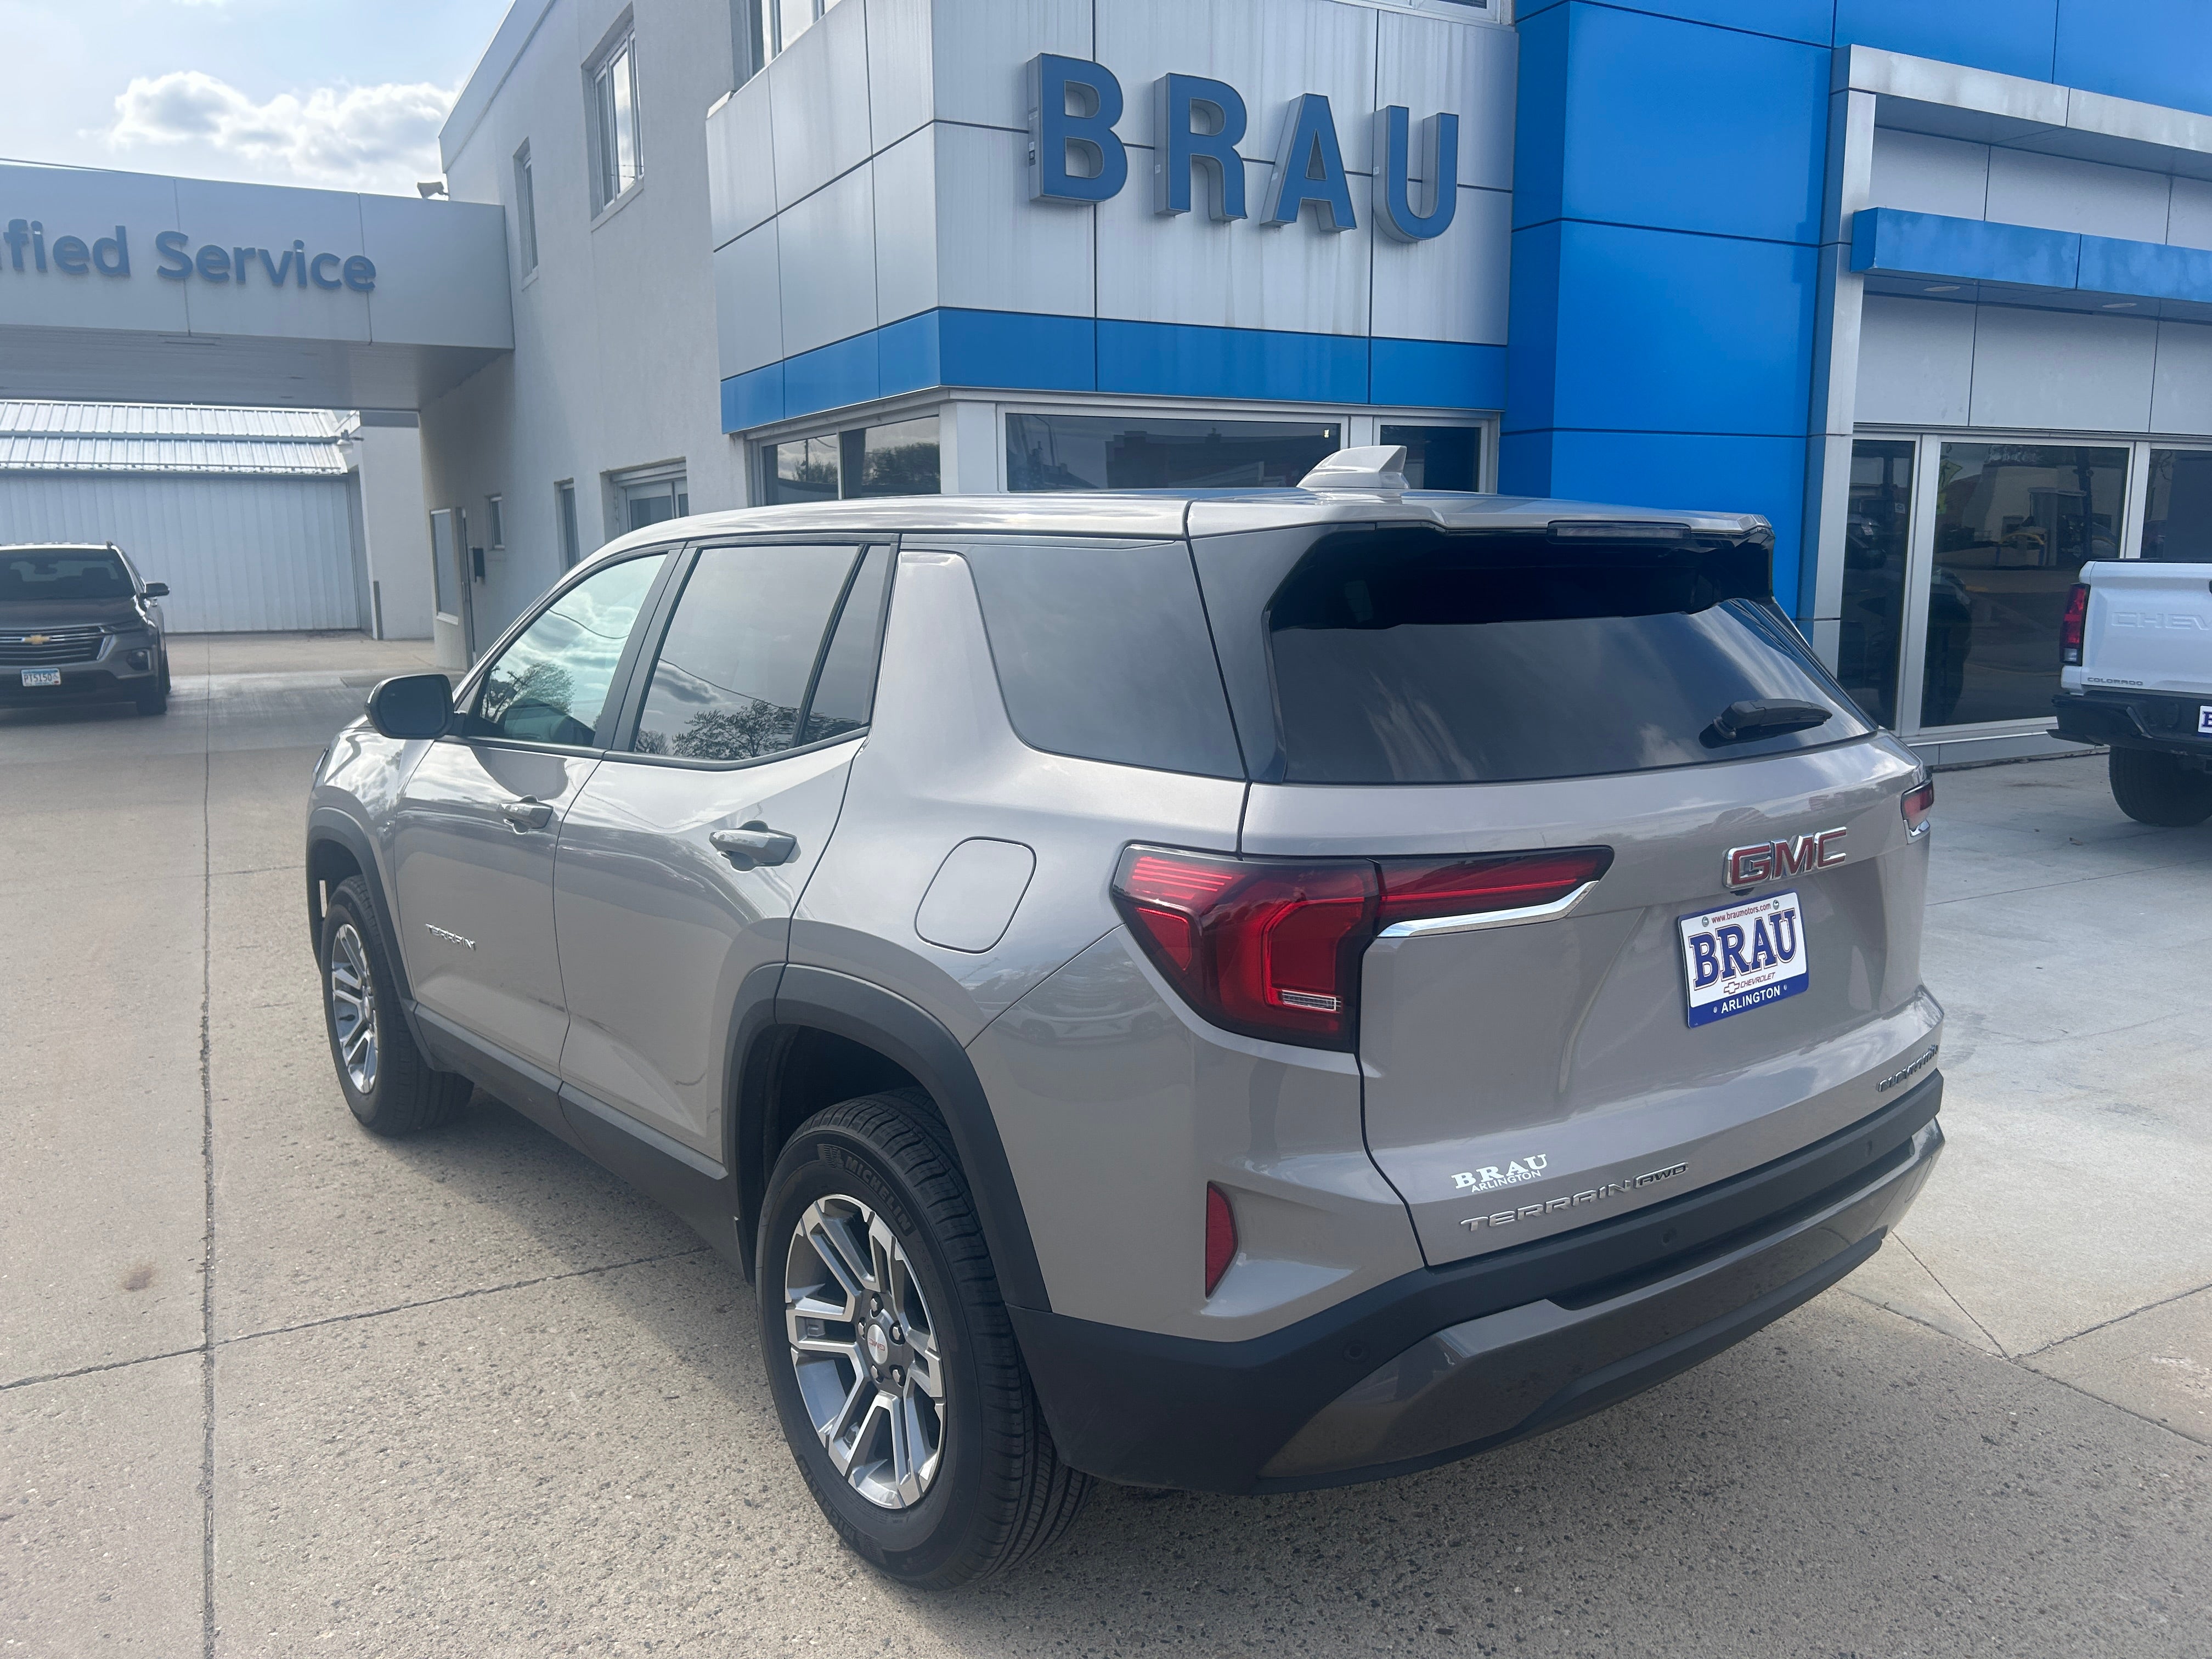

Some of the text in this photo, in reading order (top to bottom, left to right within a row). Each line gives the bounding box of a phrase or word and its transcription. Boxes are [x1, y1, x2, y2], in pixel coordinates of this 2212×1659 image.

[1027, 53, 1459, 242] BRAU
[0, 218, 377, 292] fied Service
[2087, 677, 2143, 686] COLORADO
[1723, 826, 1847, 888] GMC
[1711, 902, 1771, 924] www.braumotors.com
[1688, 907, 1797, 991] BRAU
[1720, 985, 1781, 1014] ARLINGTON
[1740, 972, 1776, 989] CHEVROLET
[845, 1155, 912, 1233] MICHELIN
[1451, 1154, 1548, 1189] BRAU
[1471, 1170, 1542, 1193] ARLINGTON
[1460, 1161, 1689, 1231] TERRAIN AWD
